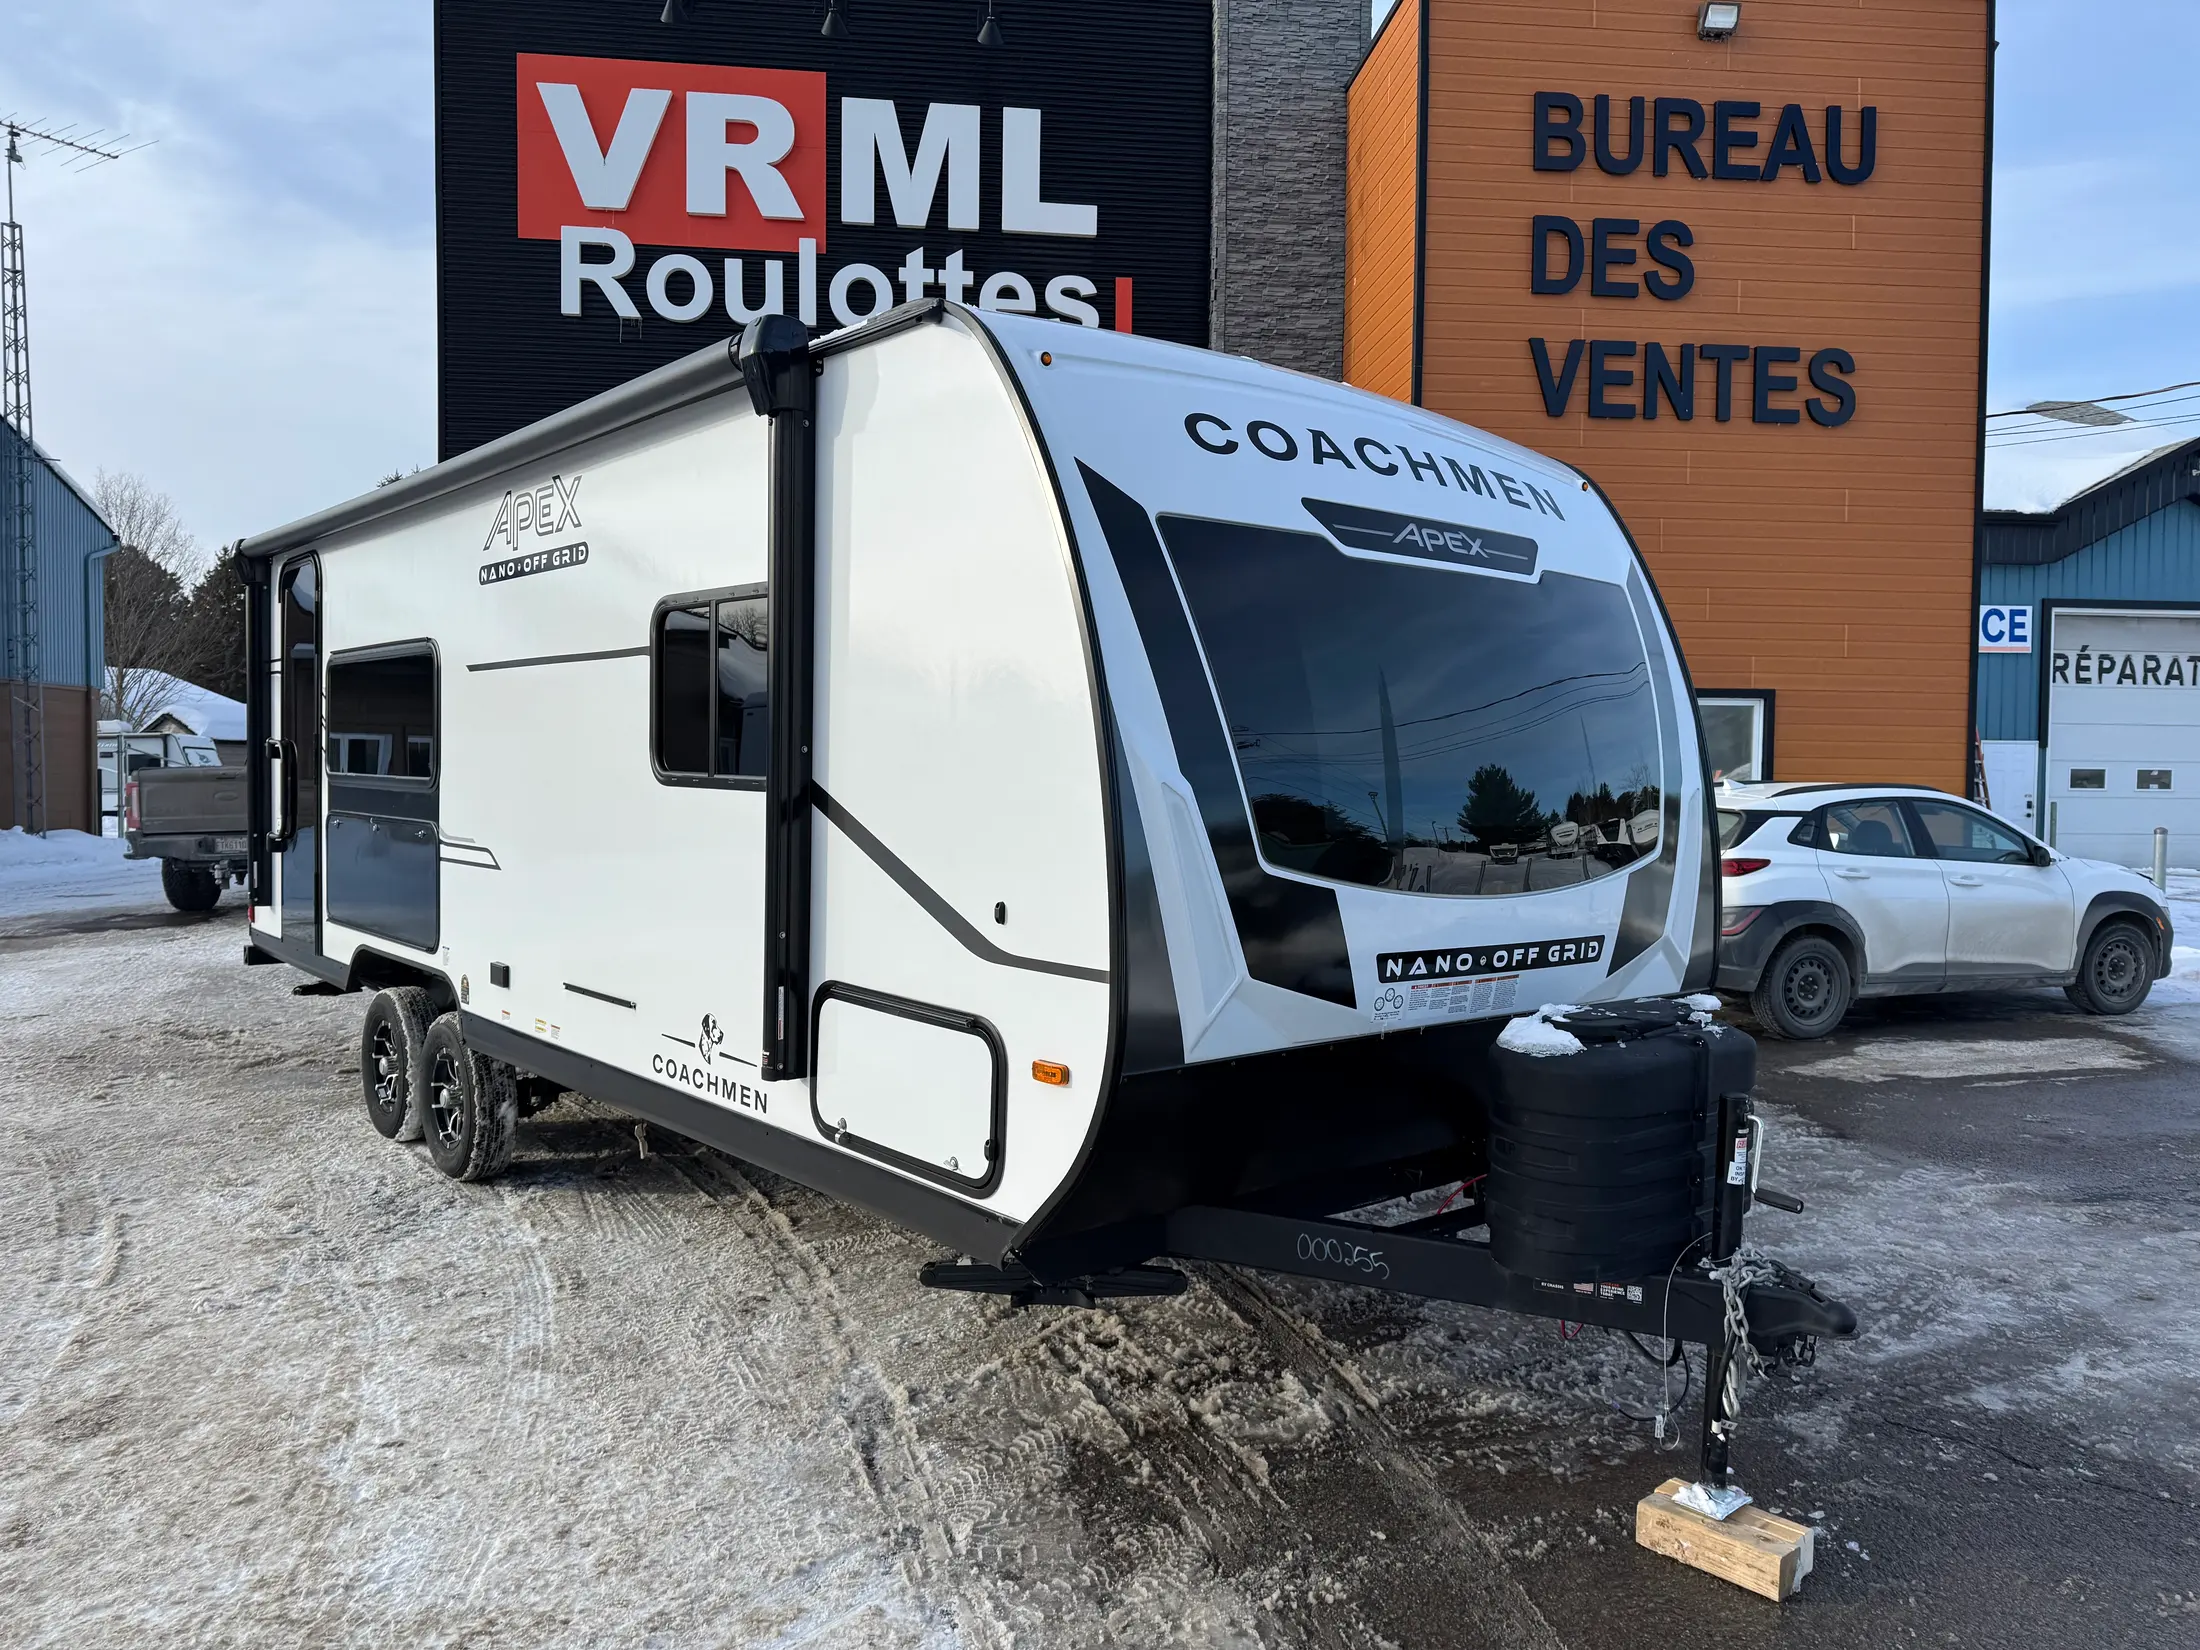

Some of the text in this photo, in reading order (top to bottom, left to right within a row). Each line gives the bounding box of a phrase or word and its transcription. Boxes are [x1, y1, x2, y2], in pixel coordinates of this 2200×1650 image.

[536, 81, 1098, 238] VRML
[1533, 91, 1877, 185] BUREAU
[560, 225, 1099, 328] Roulottes
[1531, 215, 1695, 300] DES
[1528, 337, 1856, 428] VENTES
[1184, 412, 1566, 522] COACHMEN
[483, 474, 583, 552] APEX
[1391, 522, 1490, 559] APEX
[480, 545, 587, 582] NANO OFF GRID
[1385, 940, 1600, 978] NANO OFF GRID
[652, 1053, 768, 1114] COACHMEN
[1297, 1233, 1390, 1280] 000255
